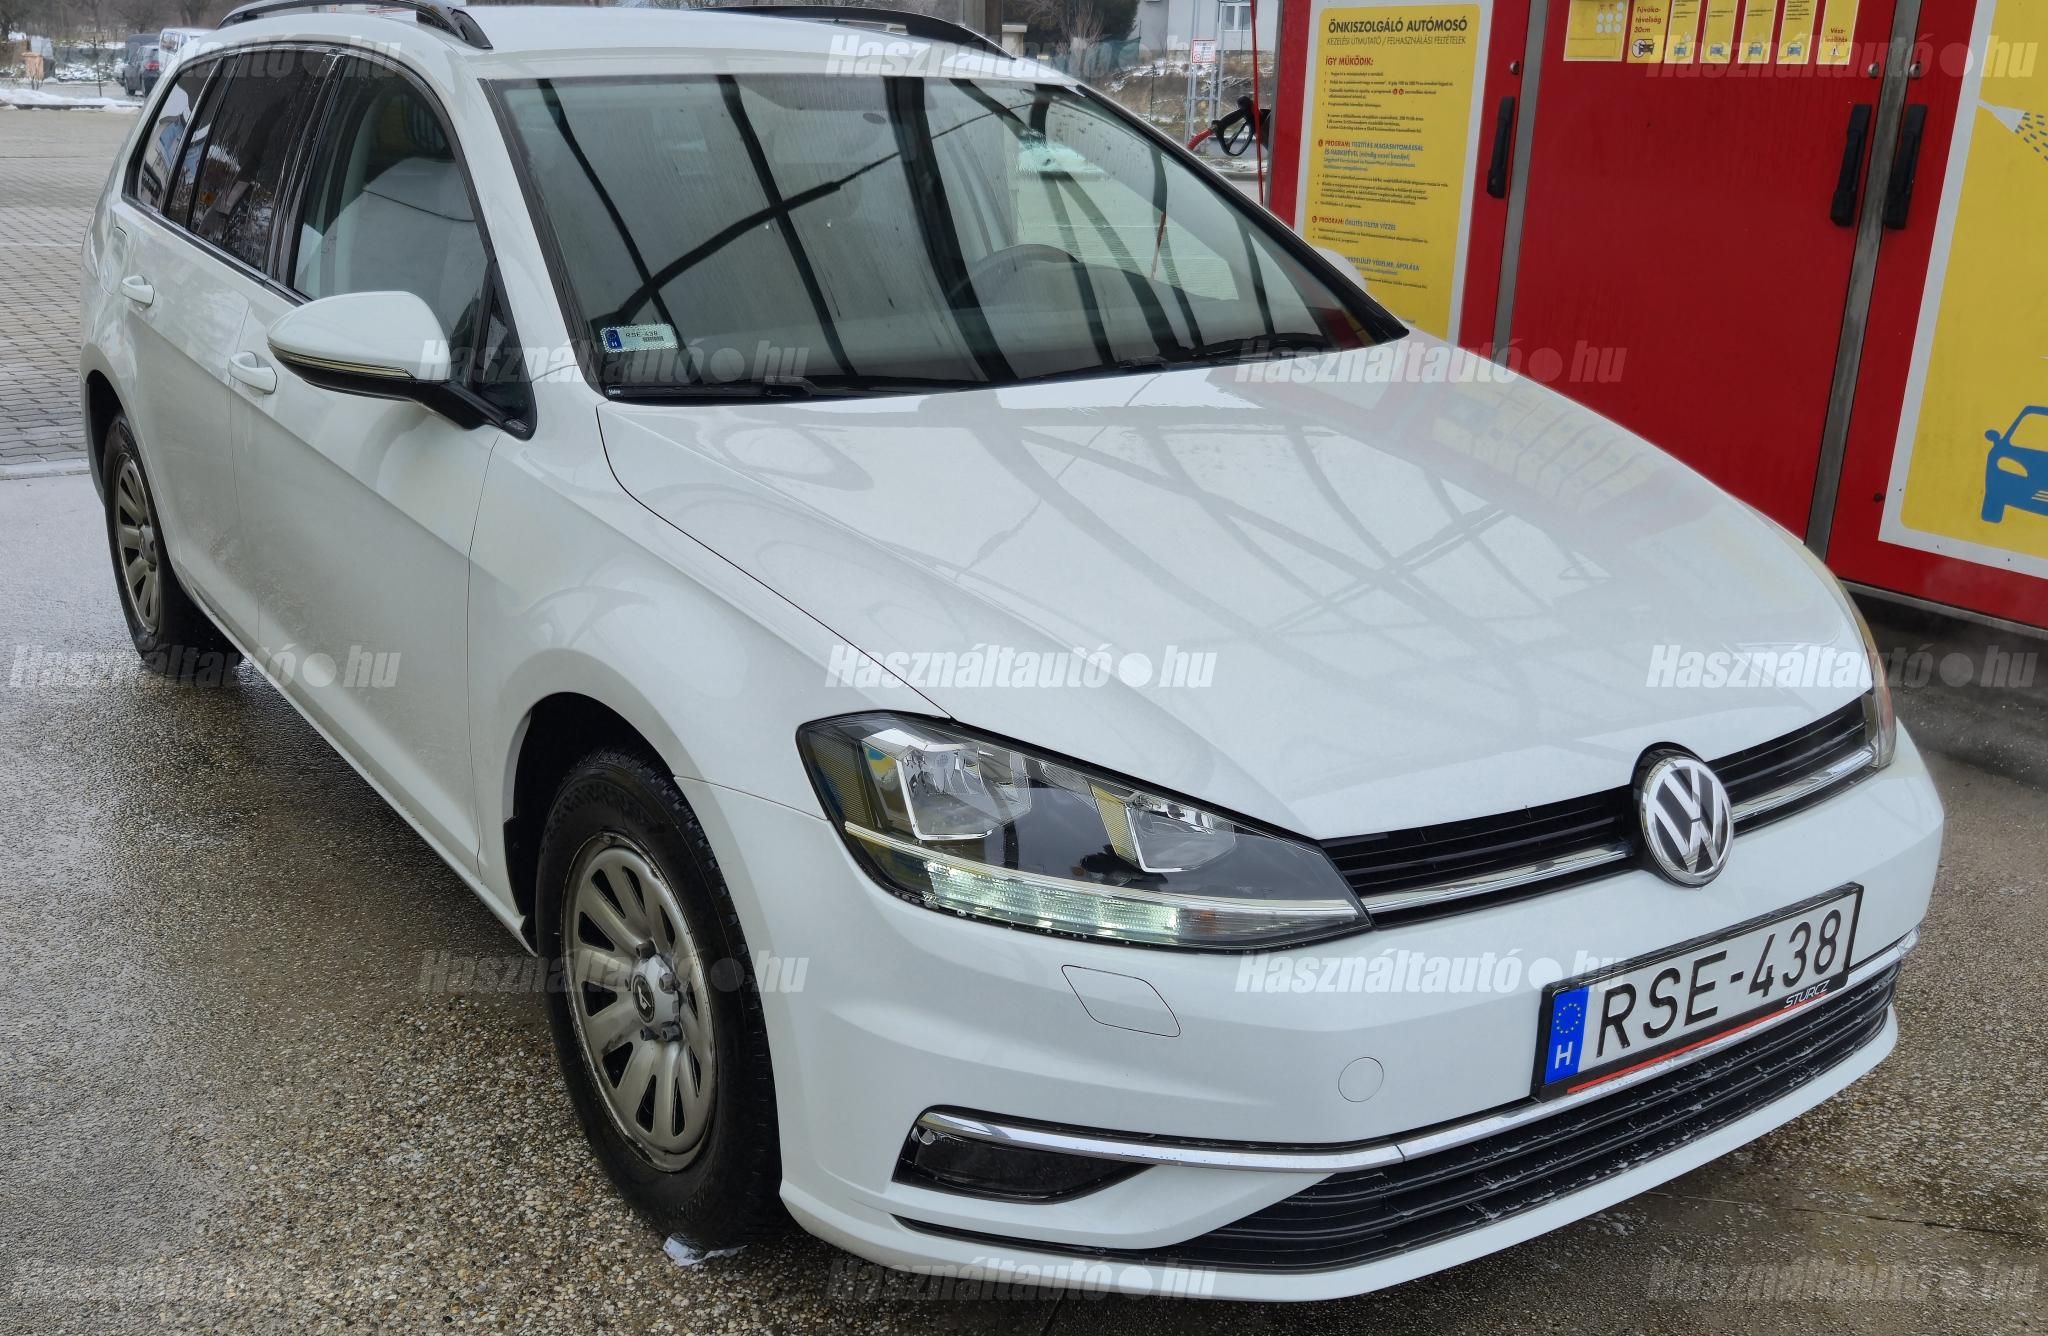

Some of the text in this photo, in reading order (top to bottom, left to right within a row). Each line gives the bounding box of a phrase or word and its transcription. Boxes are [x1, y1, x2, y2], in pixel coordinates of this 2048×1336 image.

[1328, 15, 1468, 34] ÖNKISZOLGÁLÓ AUTÓMOSÓ
[1387, 34, 1433, 45] FELHASZNÁLÁSI
[1434, 33, 1467, 45] FELTÉTELEK
[1596, 908, 1842, 1058] RSE-438
[1553, 1041, 1573, 1070] H
